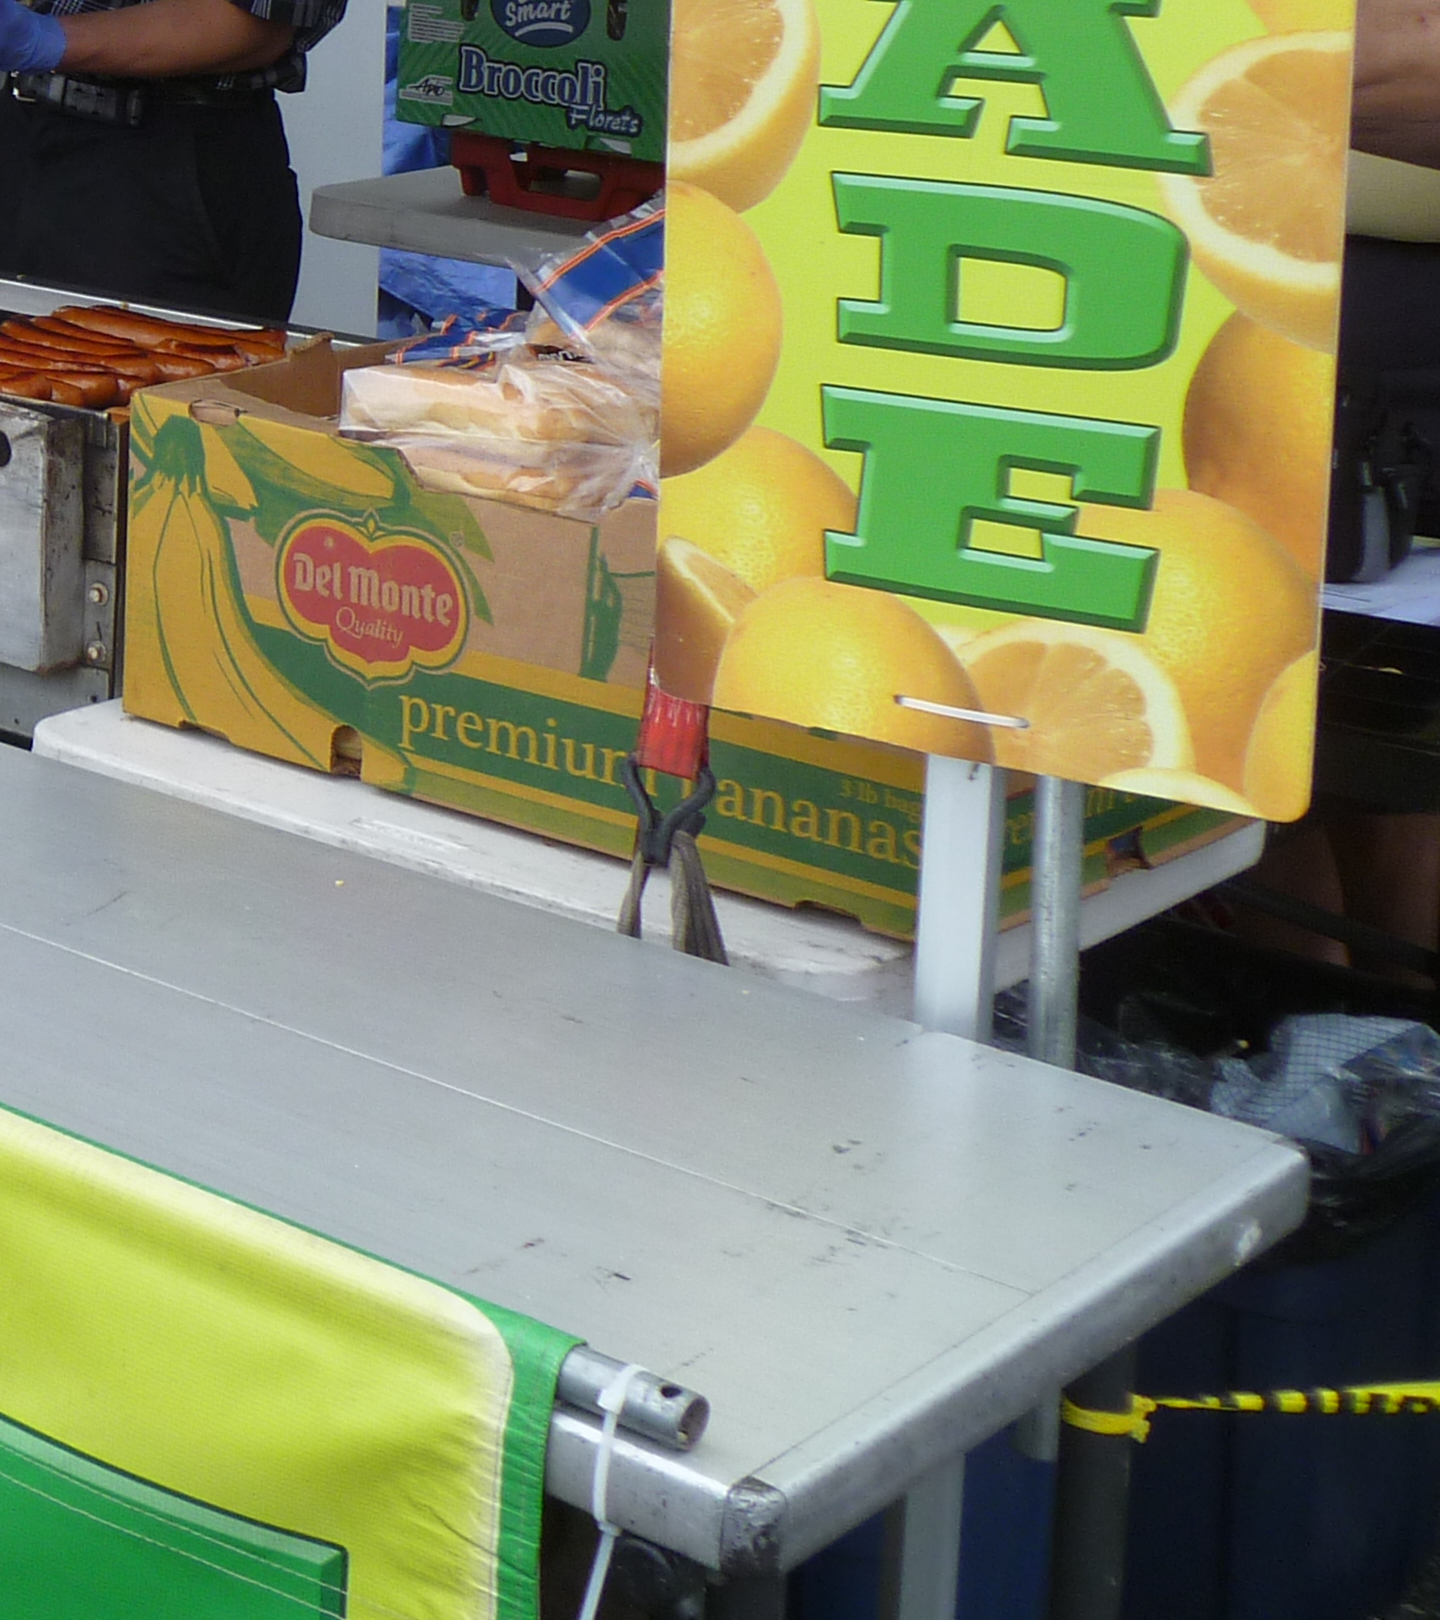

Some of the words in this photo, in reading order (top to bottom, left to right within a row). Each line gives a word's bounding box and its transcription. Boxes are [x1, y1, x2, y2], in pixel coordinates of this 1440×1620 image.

[505, 0, 571, 27] Smart
[459, 45, 606, 110] Broccoli
[569, 104, 639, 133] Florets
[294, 553, 343, 600] Del
[348, 565, 454, 627] Monte
[336, 606, 404, 648] Quality
[682, 772, 923, 871] ananas
